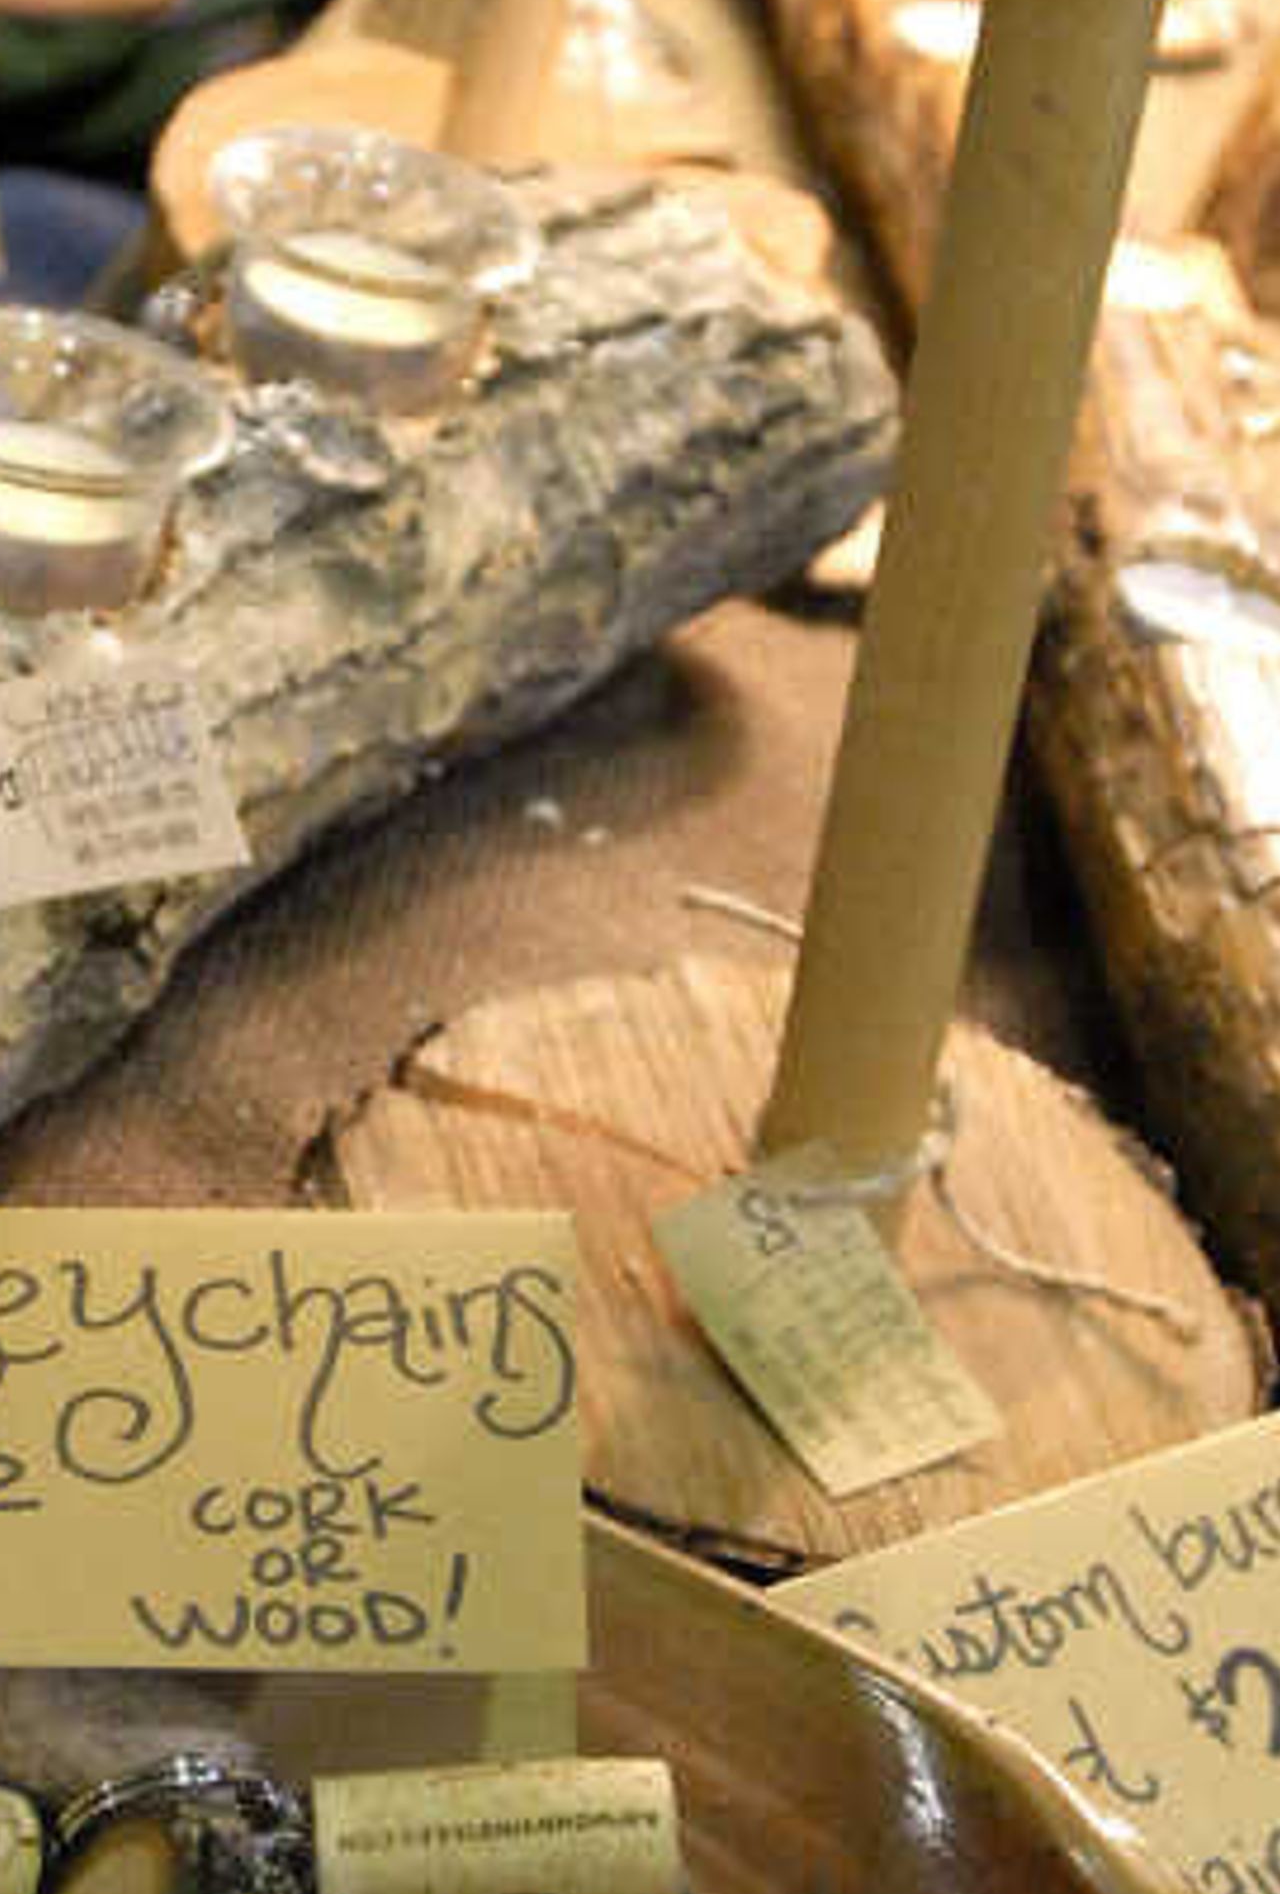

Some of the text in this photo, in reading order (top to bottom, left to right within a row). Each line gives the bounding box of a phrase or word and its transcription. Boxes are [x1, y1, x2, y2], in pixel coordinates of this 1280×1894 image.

[189, 1482, 435, 1540] CORK
[250, 1535, 360, 1588] OR
[131, 1553, 470, 1659] WOOD!
[834, 1566, 1190, 1680] ustom
